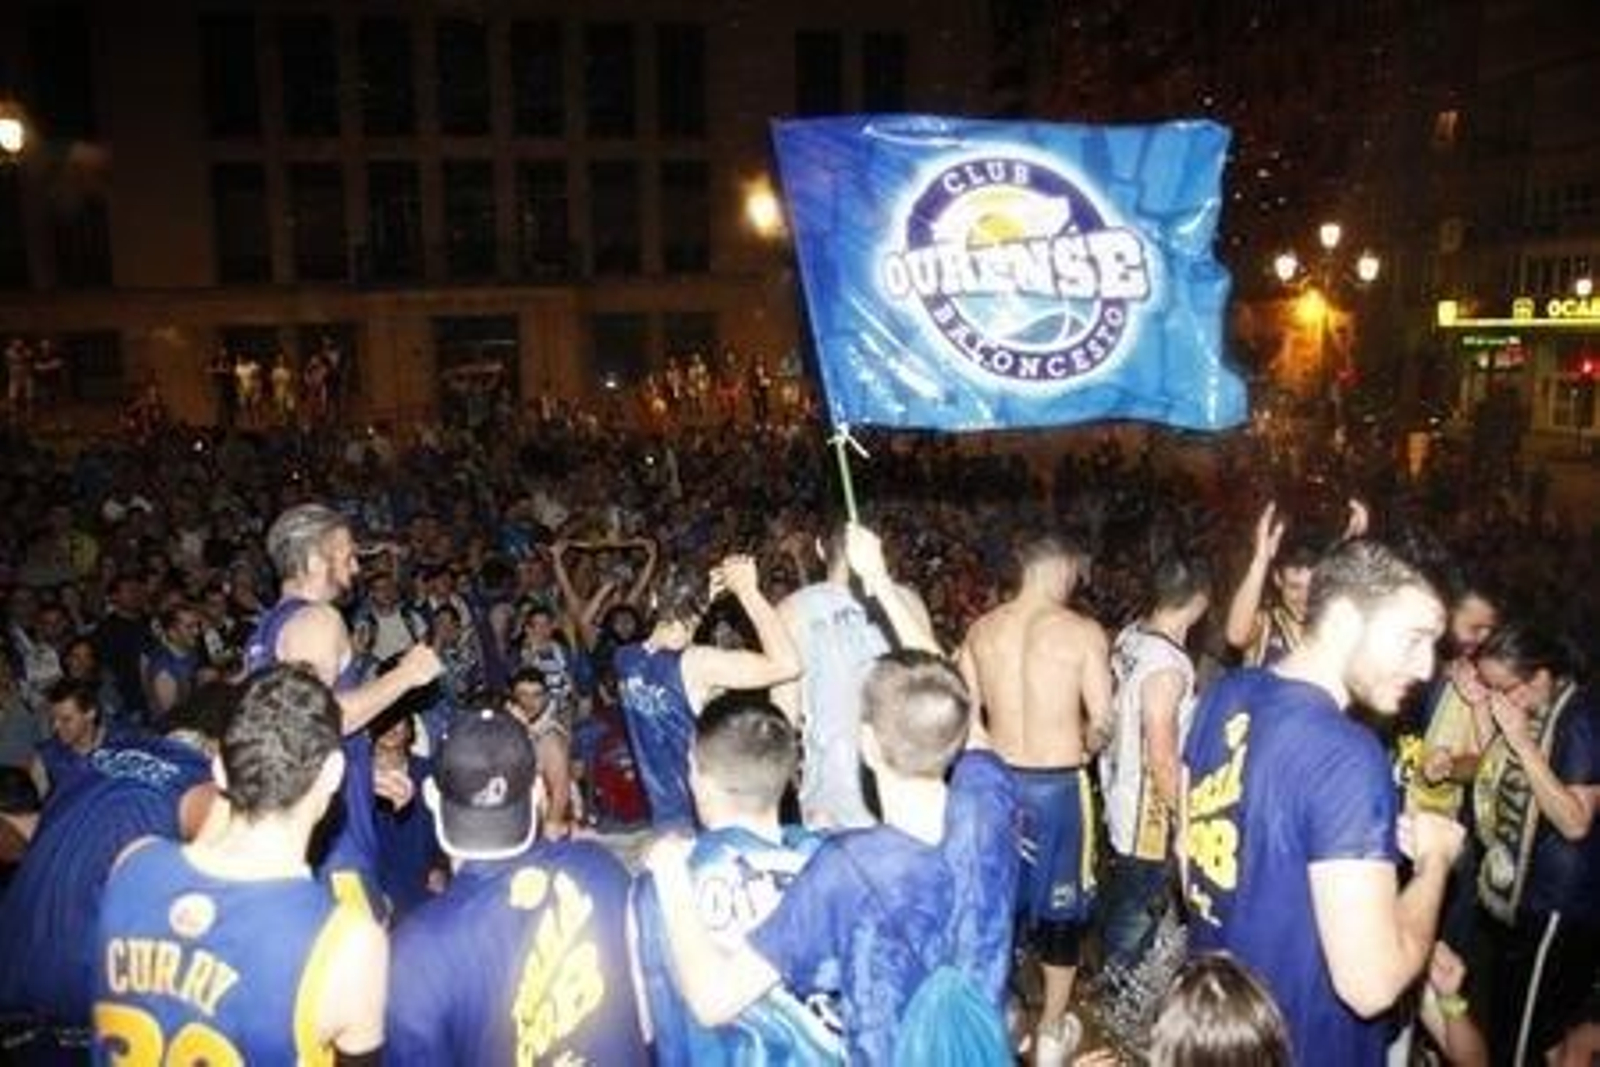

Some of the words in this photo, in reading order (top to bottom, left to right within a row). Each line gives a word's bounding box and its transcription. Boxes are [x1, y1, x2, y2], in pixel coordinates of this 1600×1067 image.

[942, 161, 1030, 194] CLUB
[885, 228, 1150, 300] OURENSE
[933, 304, 1126, 379] BALONCESTO
[107, 937, 239, 1016] CURRY
